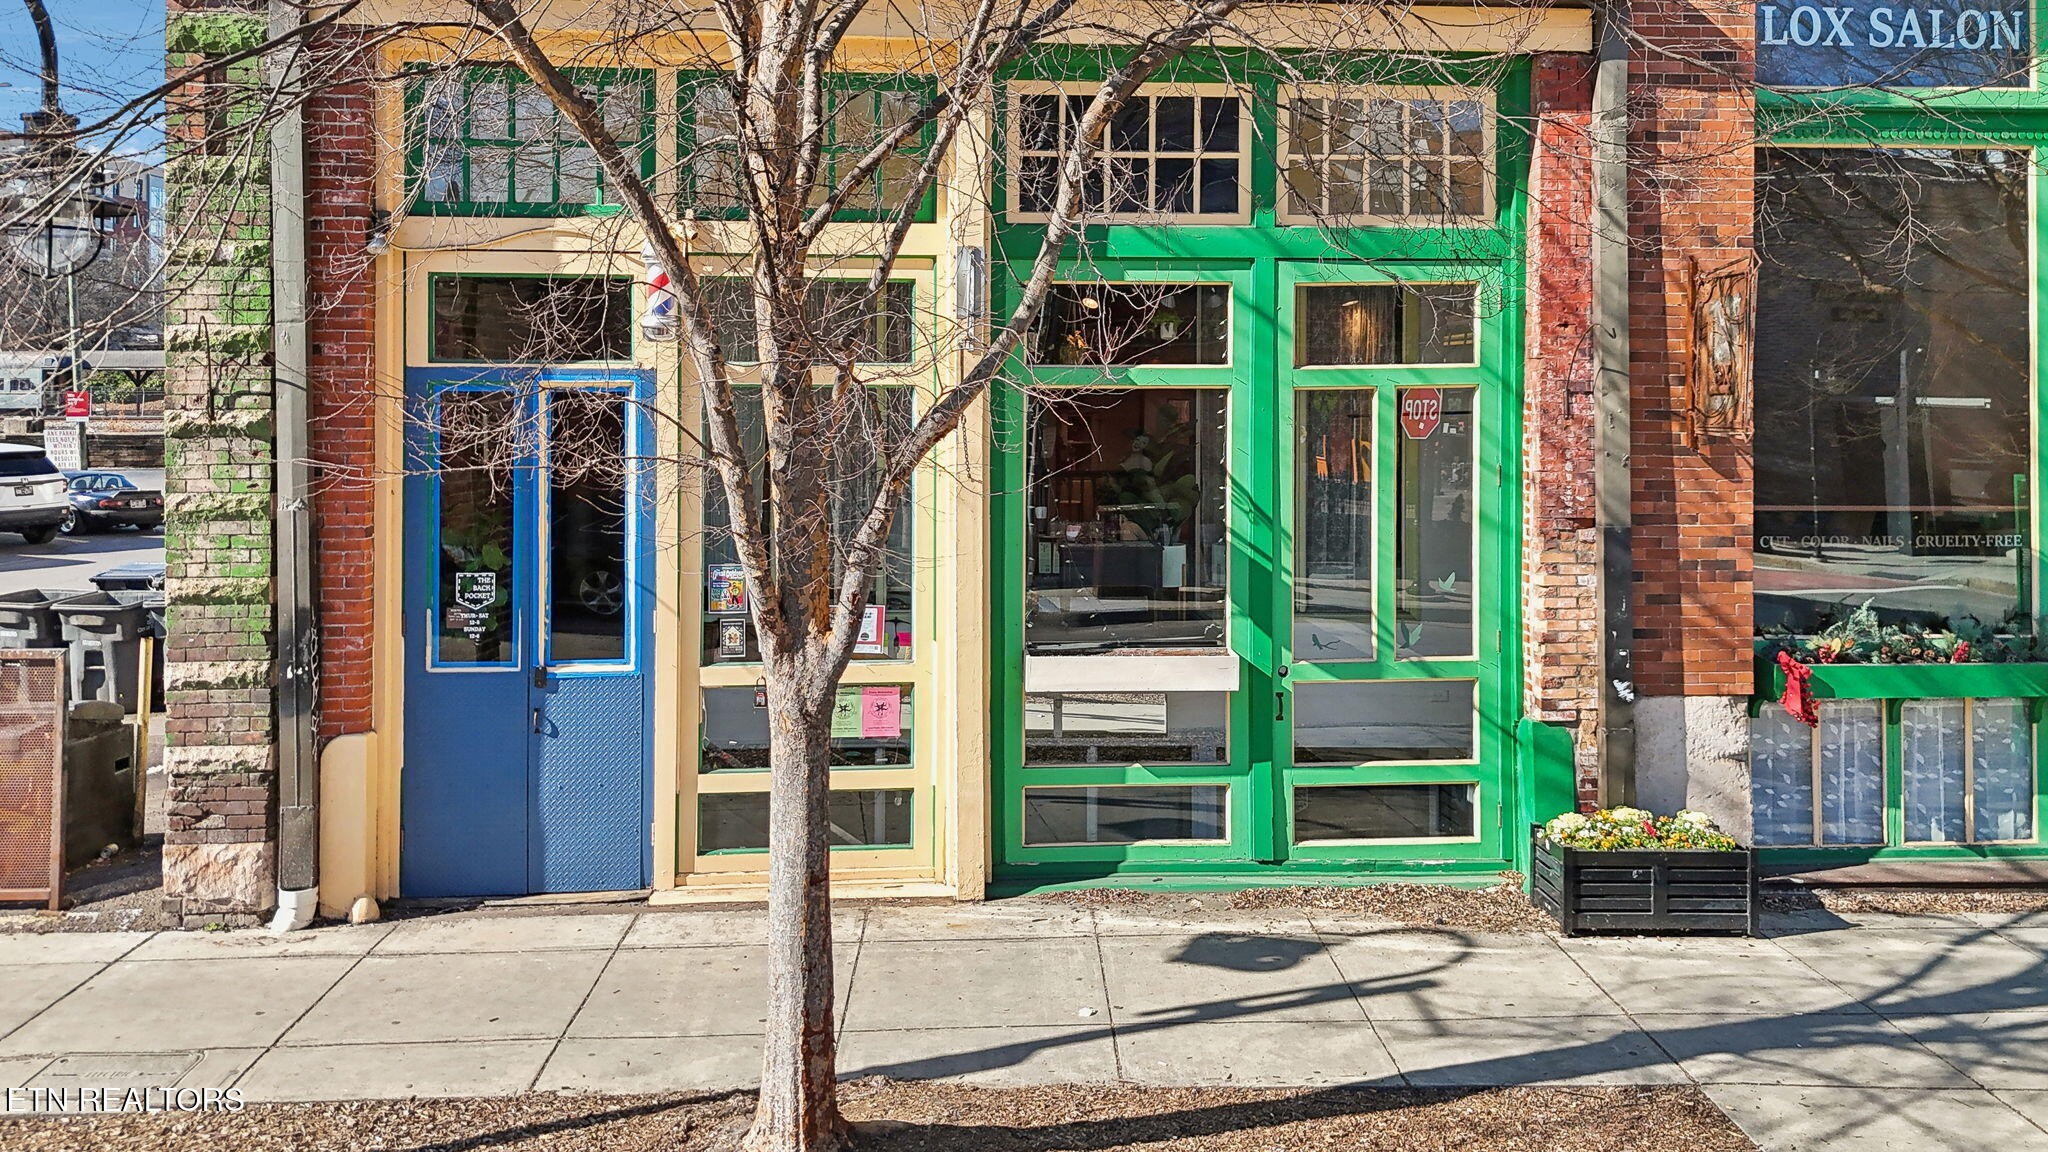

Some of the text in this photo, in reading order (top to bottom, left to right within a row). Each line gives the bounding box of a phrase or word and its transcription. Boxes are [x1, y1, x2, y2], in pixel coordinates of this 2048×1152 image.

[1760, 5, 2024, 50] LOX SALON
[1760, 534, 2023, 548] CUT COLOR NAILS CRUELTY-FREE
